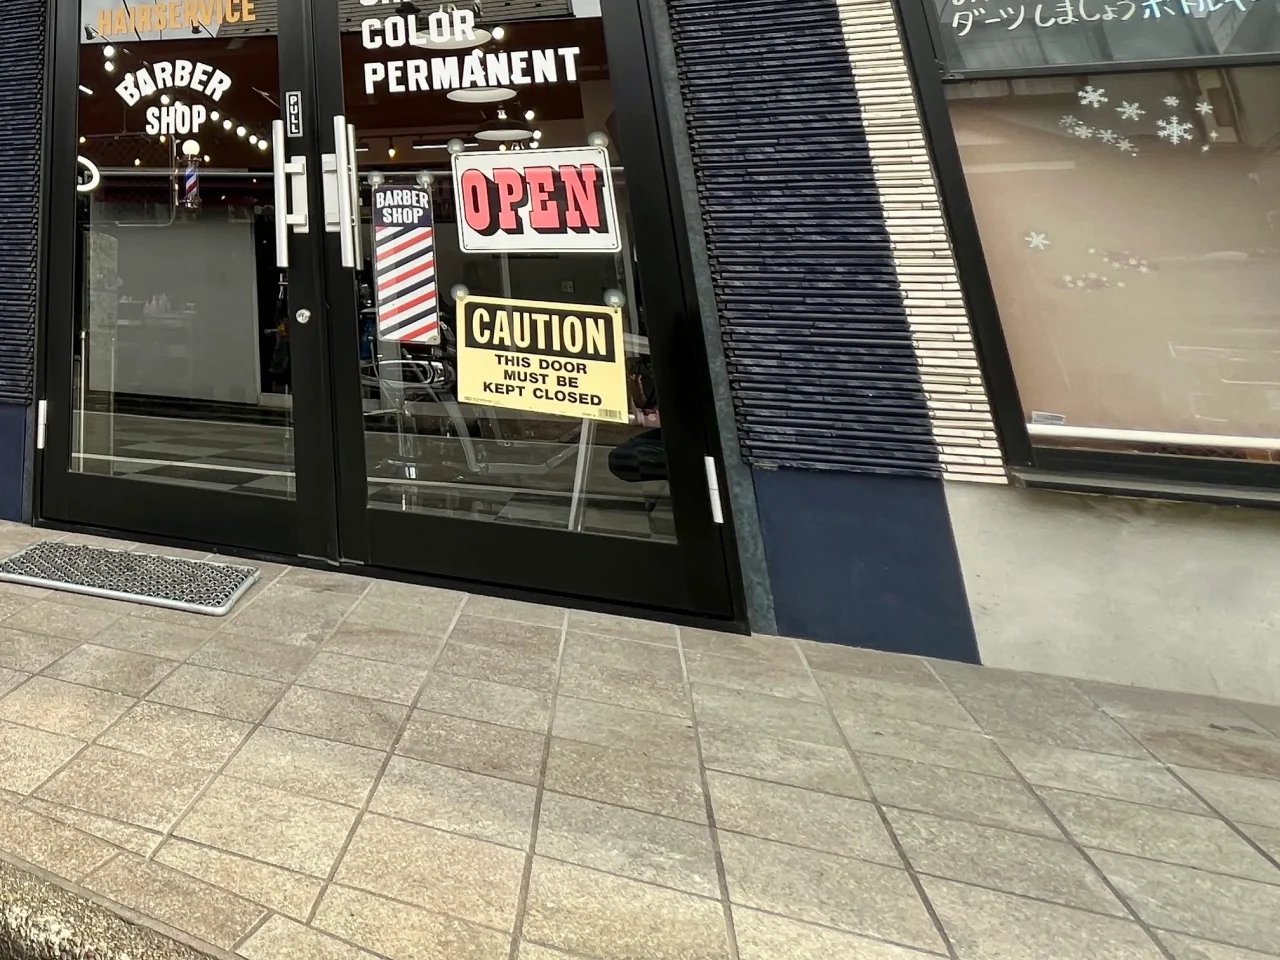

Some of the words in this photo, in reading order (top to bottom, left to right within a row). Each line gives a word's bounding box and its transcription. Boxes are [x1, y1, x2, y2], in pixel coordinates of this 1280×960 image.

[361, 9, 476, 50] COLOR
[115, 59, 232, 107] BARBER
[364, 46, 580, 95] PERMANENT
[145, 104, 207, 135] SHOP
[289, 95, 299, 133] PULL
[376, 189, 429, 209] BARBER
[382, 207, 424, 224] SHOP
[460, 163, 610, 237] OPEN
[472, 307, 608, 357] CAUTION
[495, 354, 531, 368] THIS
[538, 357, 587, 375] DOOR
[503, 369, 549, 385] MUST
[556, 374, 579, 389] BE
[483, 381, 526, 398] KEPT
[533, 386, 602, 407] CLOSED
